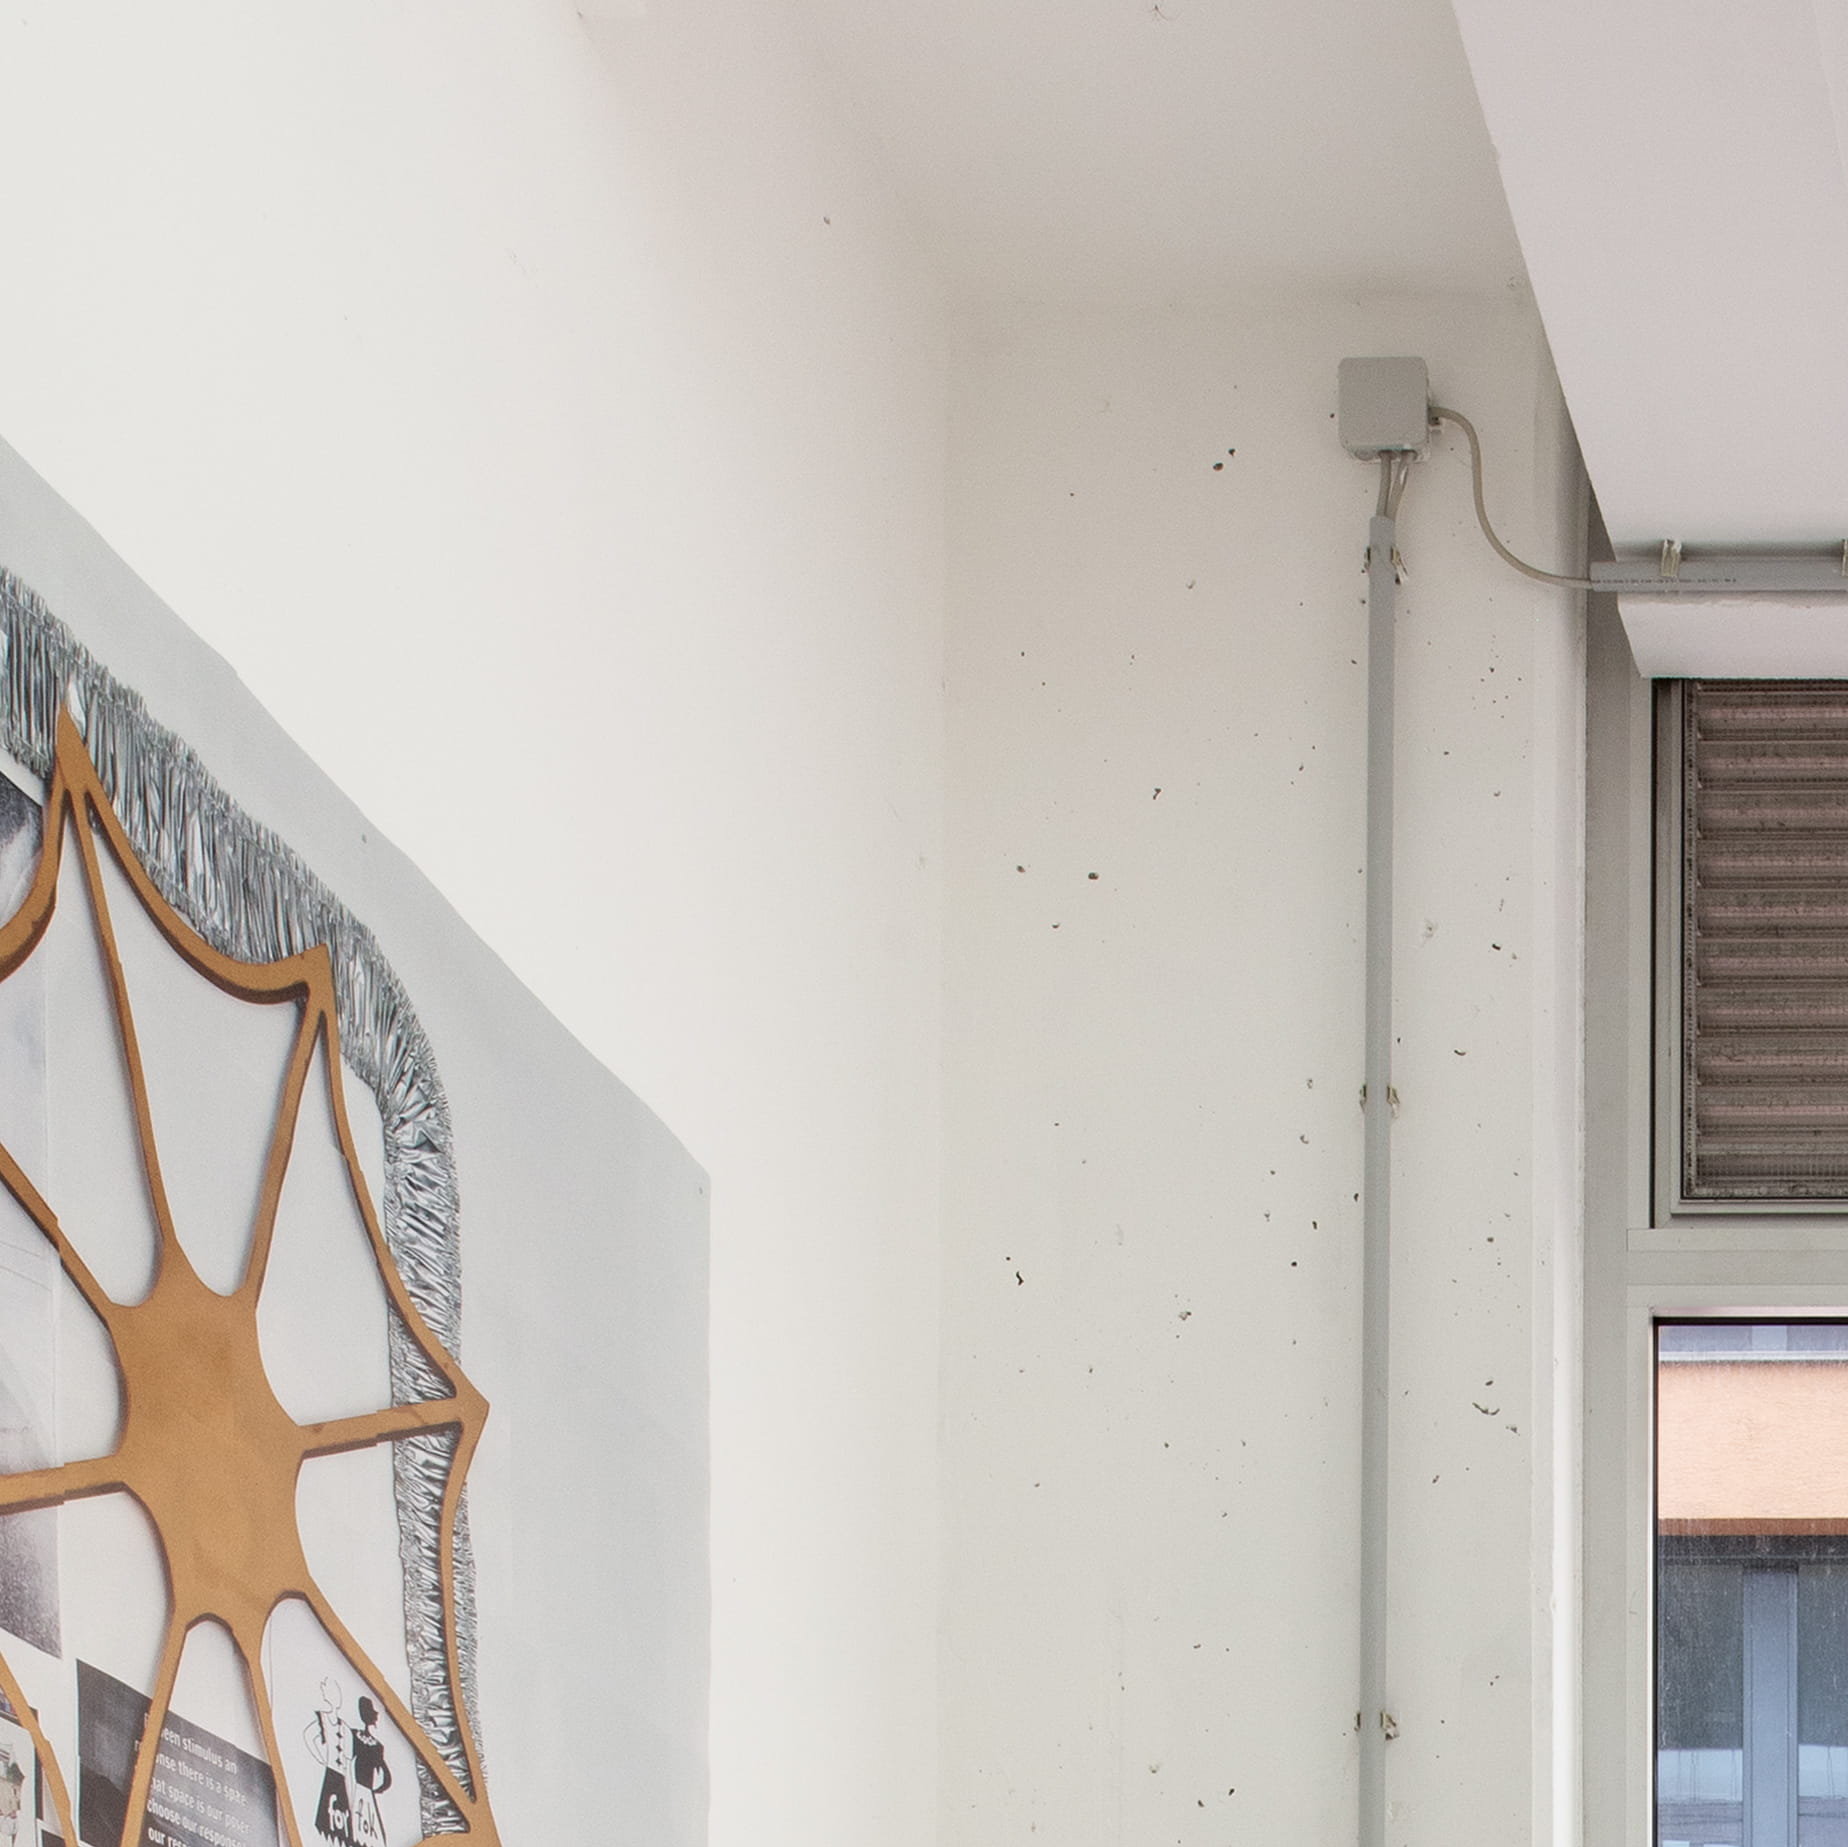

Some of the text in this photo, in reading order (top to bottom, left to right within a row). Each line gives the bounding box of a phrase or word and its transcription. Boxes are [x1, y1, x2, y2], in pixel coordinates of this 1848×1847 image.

[182, 1737, 224, 1768] stimulus
[178, 1762, 205, 1786] there
[147, 1798, 181, 1827] choose
[182, 1814, 198, 1833] our
[168, 1784, 195, 1809] space
[196, 1794, 206, 1815] is
[207, 1803, 223, 1822] our
[328, 1794, 350, 1838] for
[148, 1826, 166, 1845] our
